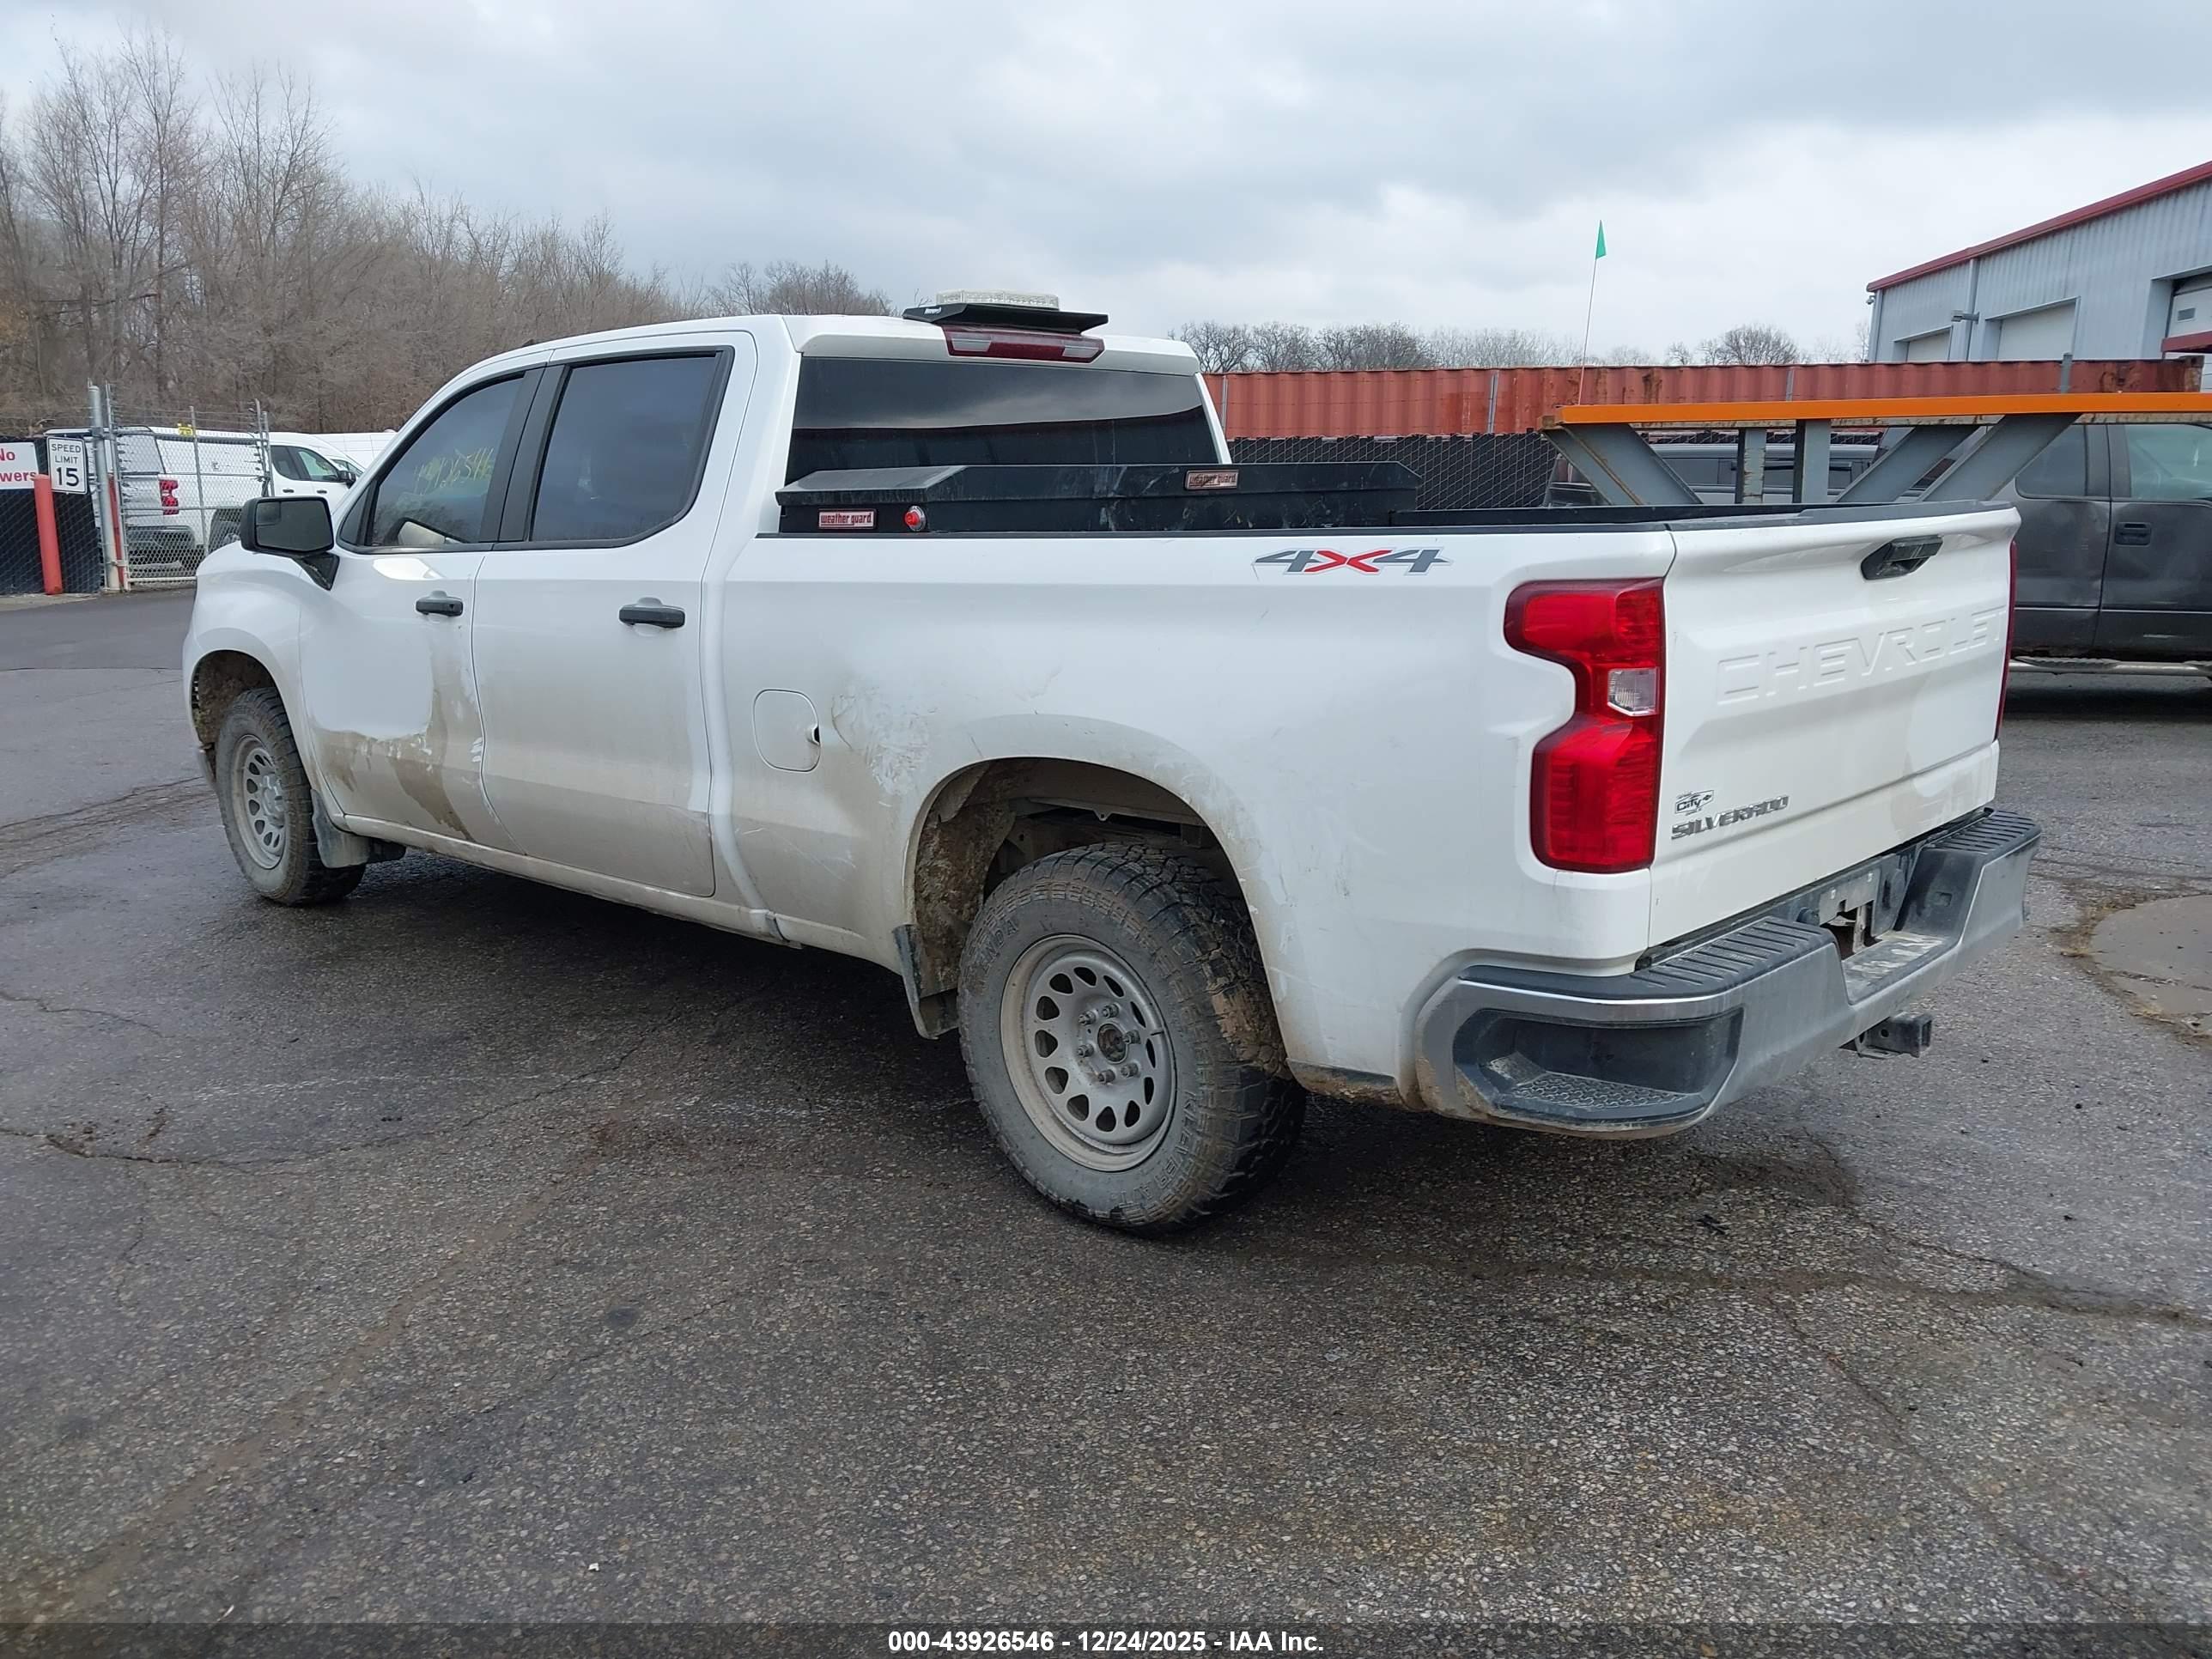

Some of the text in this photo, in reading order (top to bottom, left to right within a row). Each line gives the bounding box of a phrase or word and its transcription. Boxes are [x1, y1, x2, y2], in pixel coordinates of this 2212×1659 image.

[52, 444, 82, 453] SPEED
[57, 467, 79, 487] 15
[821, 513, 872, 524] weather guard
[1717, 604, 2007, 706] CHEVROLET
[1671, 796, 1790, 840] SILVERADO
